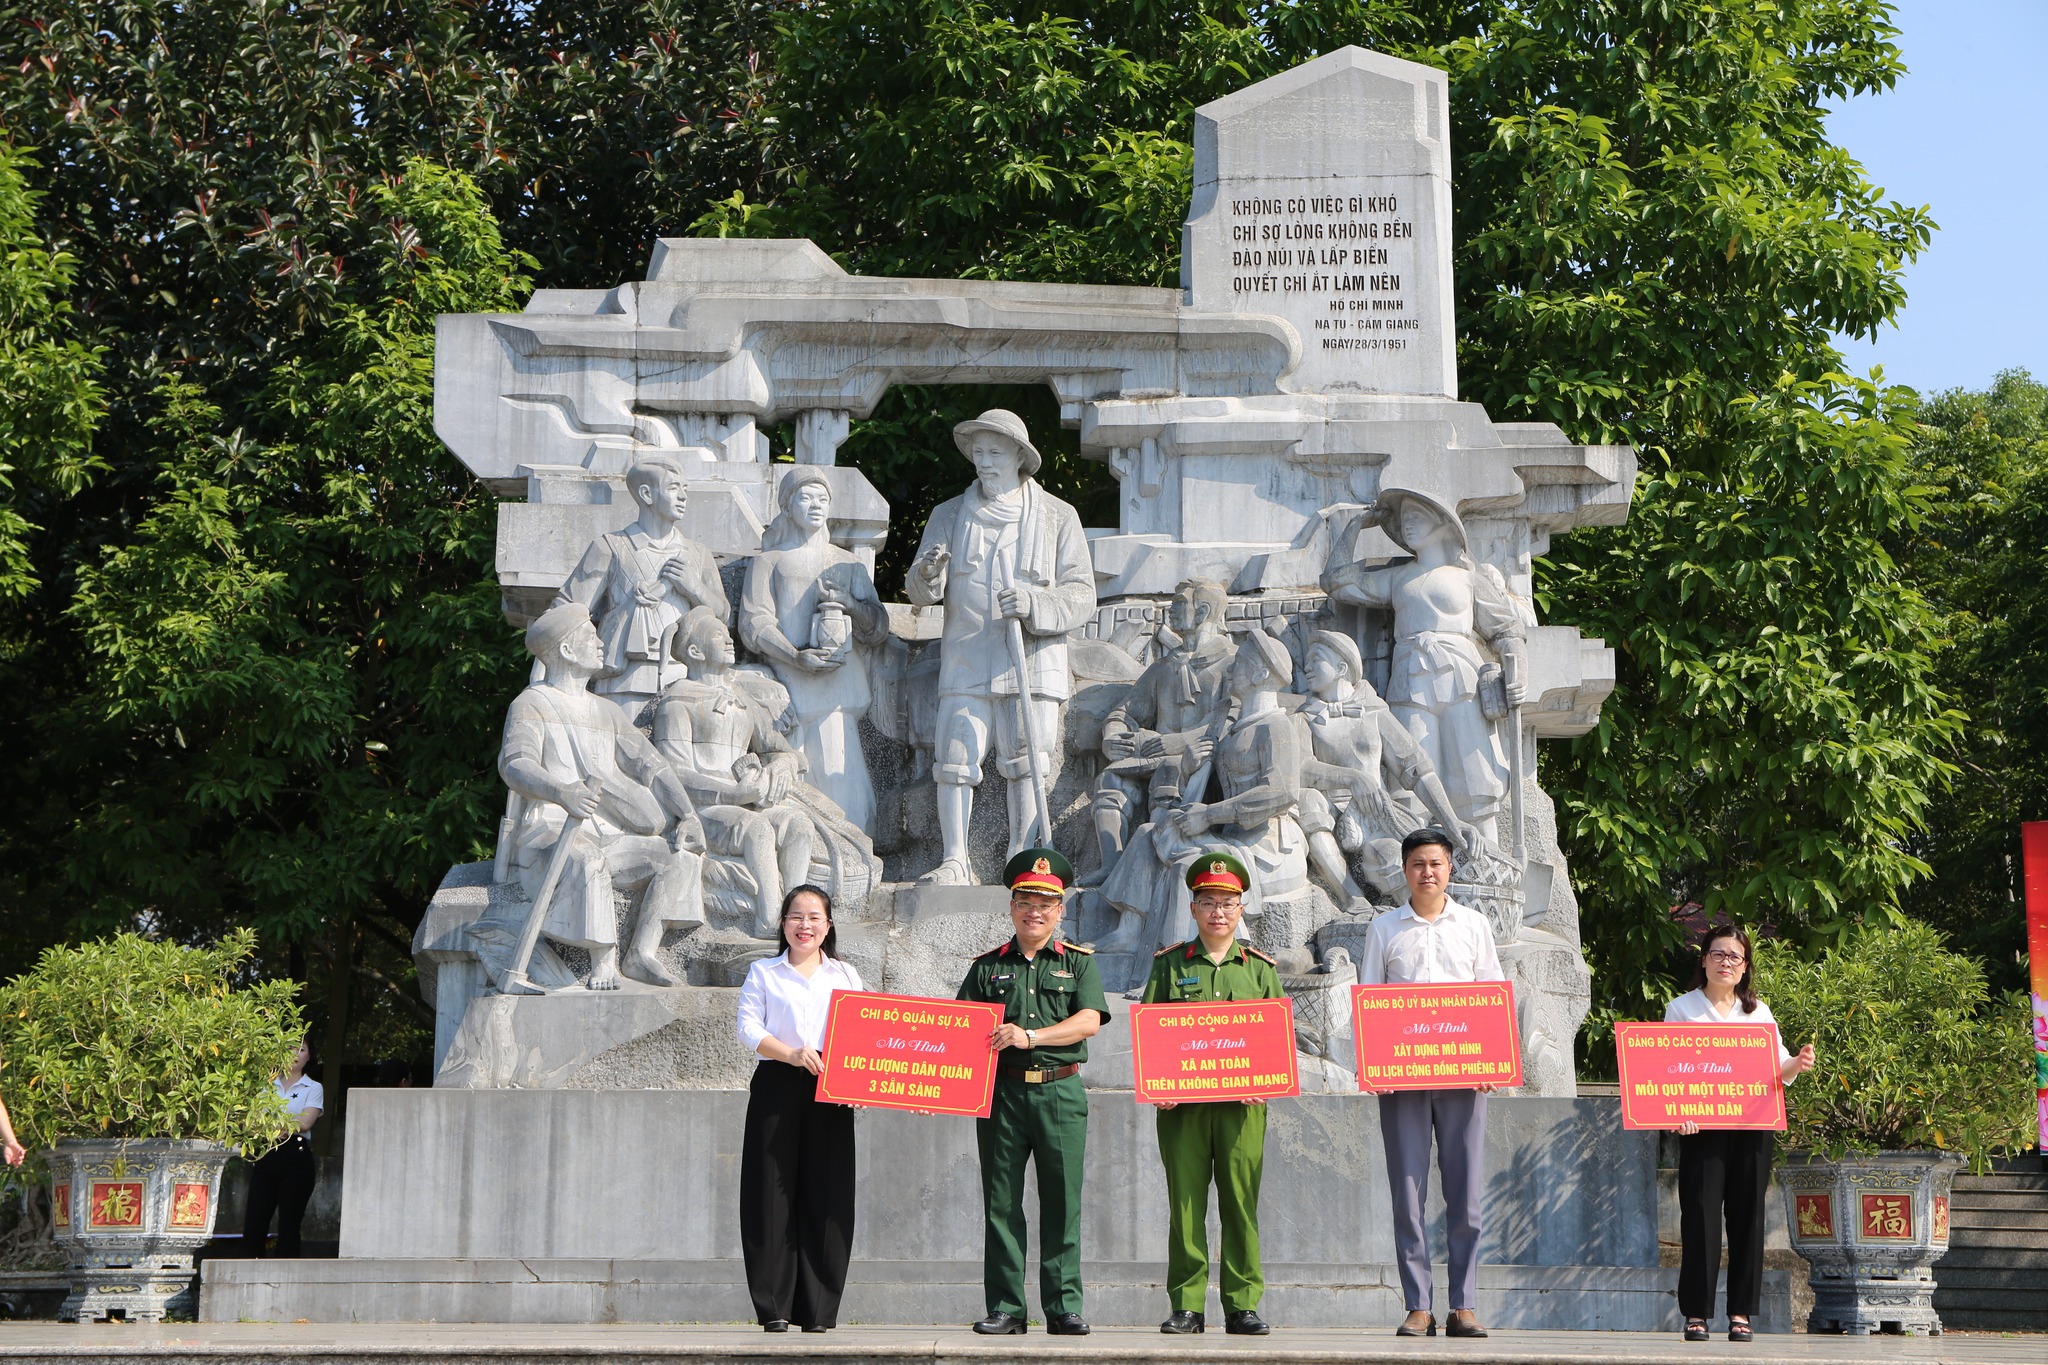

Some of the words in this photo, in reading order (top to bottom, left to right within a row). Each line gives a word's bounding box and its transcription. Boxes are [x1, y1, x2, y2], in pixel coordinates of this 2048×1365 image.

[1233, 197, 1281, 215] KHÔNG
[1288, 195, 1305, 214] CÓ
[1311, 196, 1343, 217] VIỆC
[1350, 194, 1362, 213] GÌ
[1369, 193, 1396, 212] KHÓ
[1234, 220, 1257, 241] CHỈ
[1262, 224, 1280, 243] SỢ
[1287, 221, 1323, 239] LÒNG
[1329, 222, 1377, 239] KHÔNG
[1384, 217, 1412, 238] BỀN
[1232, 249, 1261, 266] ĐÀO
[1268, 247, 1291, 265] NÚI
[1298, 247, 1315, 265] VÀ
[1321, 244, 1347, 264] LẤP
[1354, 243, 1387, 265] BIỂN
[1234, 271, 1278, 293] QUYẾT
[1284, 275, 1306, 291] CHÍ
[1335, 274, 1364, 291] LÀM
[1370, 273, 1400, 290] NÊN
[1349, 298, 1367, 310] CHÍ
[1373, 300, 1403, 310] MINH
[1334, 320, 1346, 329] TU
[1363, 996, 1389, 1009] ĐẢNG
[1392, 996, 1404, 1011] BỘ
[1421, 998, 1439, 1008] BAN
[1442, 995, 1466, 1007] NHÂN
[1469, 994, 1488, 1006] DÂN
[1490, 994, 1503, 1006] XÃ
[860, 1008, 880, 1020] CHI
[884, 1008, 899, 1026] BỘ
[903, 1011, 934, 1025] QUÂN
[938, 1015, 952, 1030] SỰ
[954, 1015, 970, 1028] XÃ
[1159, 1017, 1177, 1027] CHI
[1181, 1014, 1194, 1029] BỘ
[1198, 1013, 1229, 1026] CÔNG
[1232, 1014, 1247, 1023] AN
[1250, 1011, 1264, 1023] XÃ
[1403, 1023, 1430, 1034] Mô
[1432, 1022, 1468, 1033] Hình
[876, 1038, 905, 1049] Mô
[909, 1039, 946, 1053] Hình
[1181, 1038, 1208, 1050] Mô
[1211, 1038, 1246, 1048] Hình
[1394, 1043, 1411, 1057] XÂY
[1415, 1043, 1439, 1059] DỰNG
[1442, 1041, 1457, 1055] MÔ
[1460, 1041, 1481, 1054] HÌNH
[1628, 1034, 1654, 1047] ĐẢNG
[1658, 1035, 1670, 1050] BỘ
[1673, 1034, 1692, 1047] CÁC
[1696, 1036, 1709, 1047] CƠ
[1712, 1037, 1738, 1048] QUAN
[1740, 1034, 1766, 1047] ĐẢNG
[843, 1056, 867, 1070] LỰC
[870, 1058, 909, 1075] LƯỢNG
[912, 1061, 936, 1076] DÂN
[940, 1064, 972, 1080] QUÂN
[1181, 1058, 1196, 1071] XÃ
[1200, 1059, 1216, 1070] AN
[1219, 1056, 1250, 1070] TOÀN
[1368, 1066, 1380, 1077] DU
[1383, 1065, 1403, 1079] LỊCH
[1406, 1062, 1431, 1078] CỘNG
[1462, 1061, 1495, 1074] PHIÊNG
[1498, 1062, 1511, 1073] AN
[1668, 1062, 1695, 1073] Mô
[1697, 1062, 1733, 1073] Hình
[869, 1080, 876, 1091] 3
[880, 1078, 905, 1095] SẴN
[908, 1081, 941, 1098] SÀNG
[1146, 1076, 1175, 1090] TRÊN
[1179, 1075, 1218, 1089] KHÔNG
[1222, 1076, 1250, 1088] GIAN
[1254, 1073, 1288, 1088] MẠNG
[1635, 1080, 1659, 1095] MỖI
[1662, 1080, 1685, 1096] QUÝ
[1689, 1082, 1713, 1099] MỘT
[1719, 1082, 1744, 1099] VIỆC
[1748, 1080, 1768, 1096] TỐT
[1665, 1101, 1676, 1115] VÌ
[1680, 1101, 1714, 1116] NHÂN
[1718, 1101, 1742, 1116] DÂN
[1868, 1198, 1907, 1234] 福
